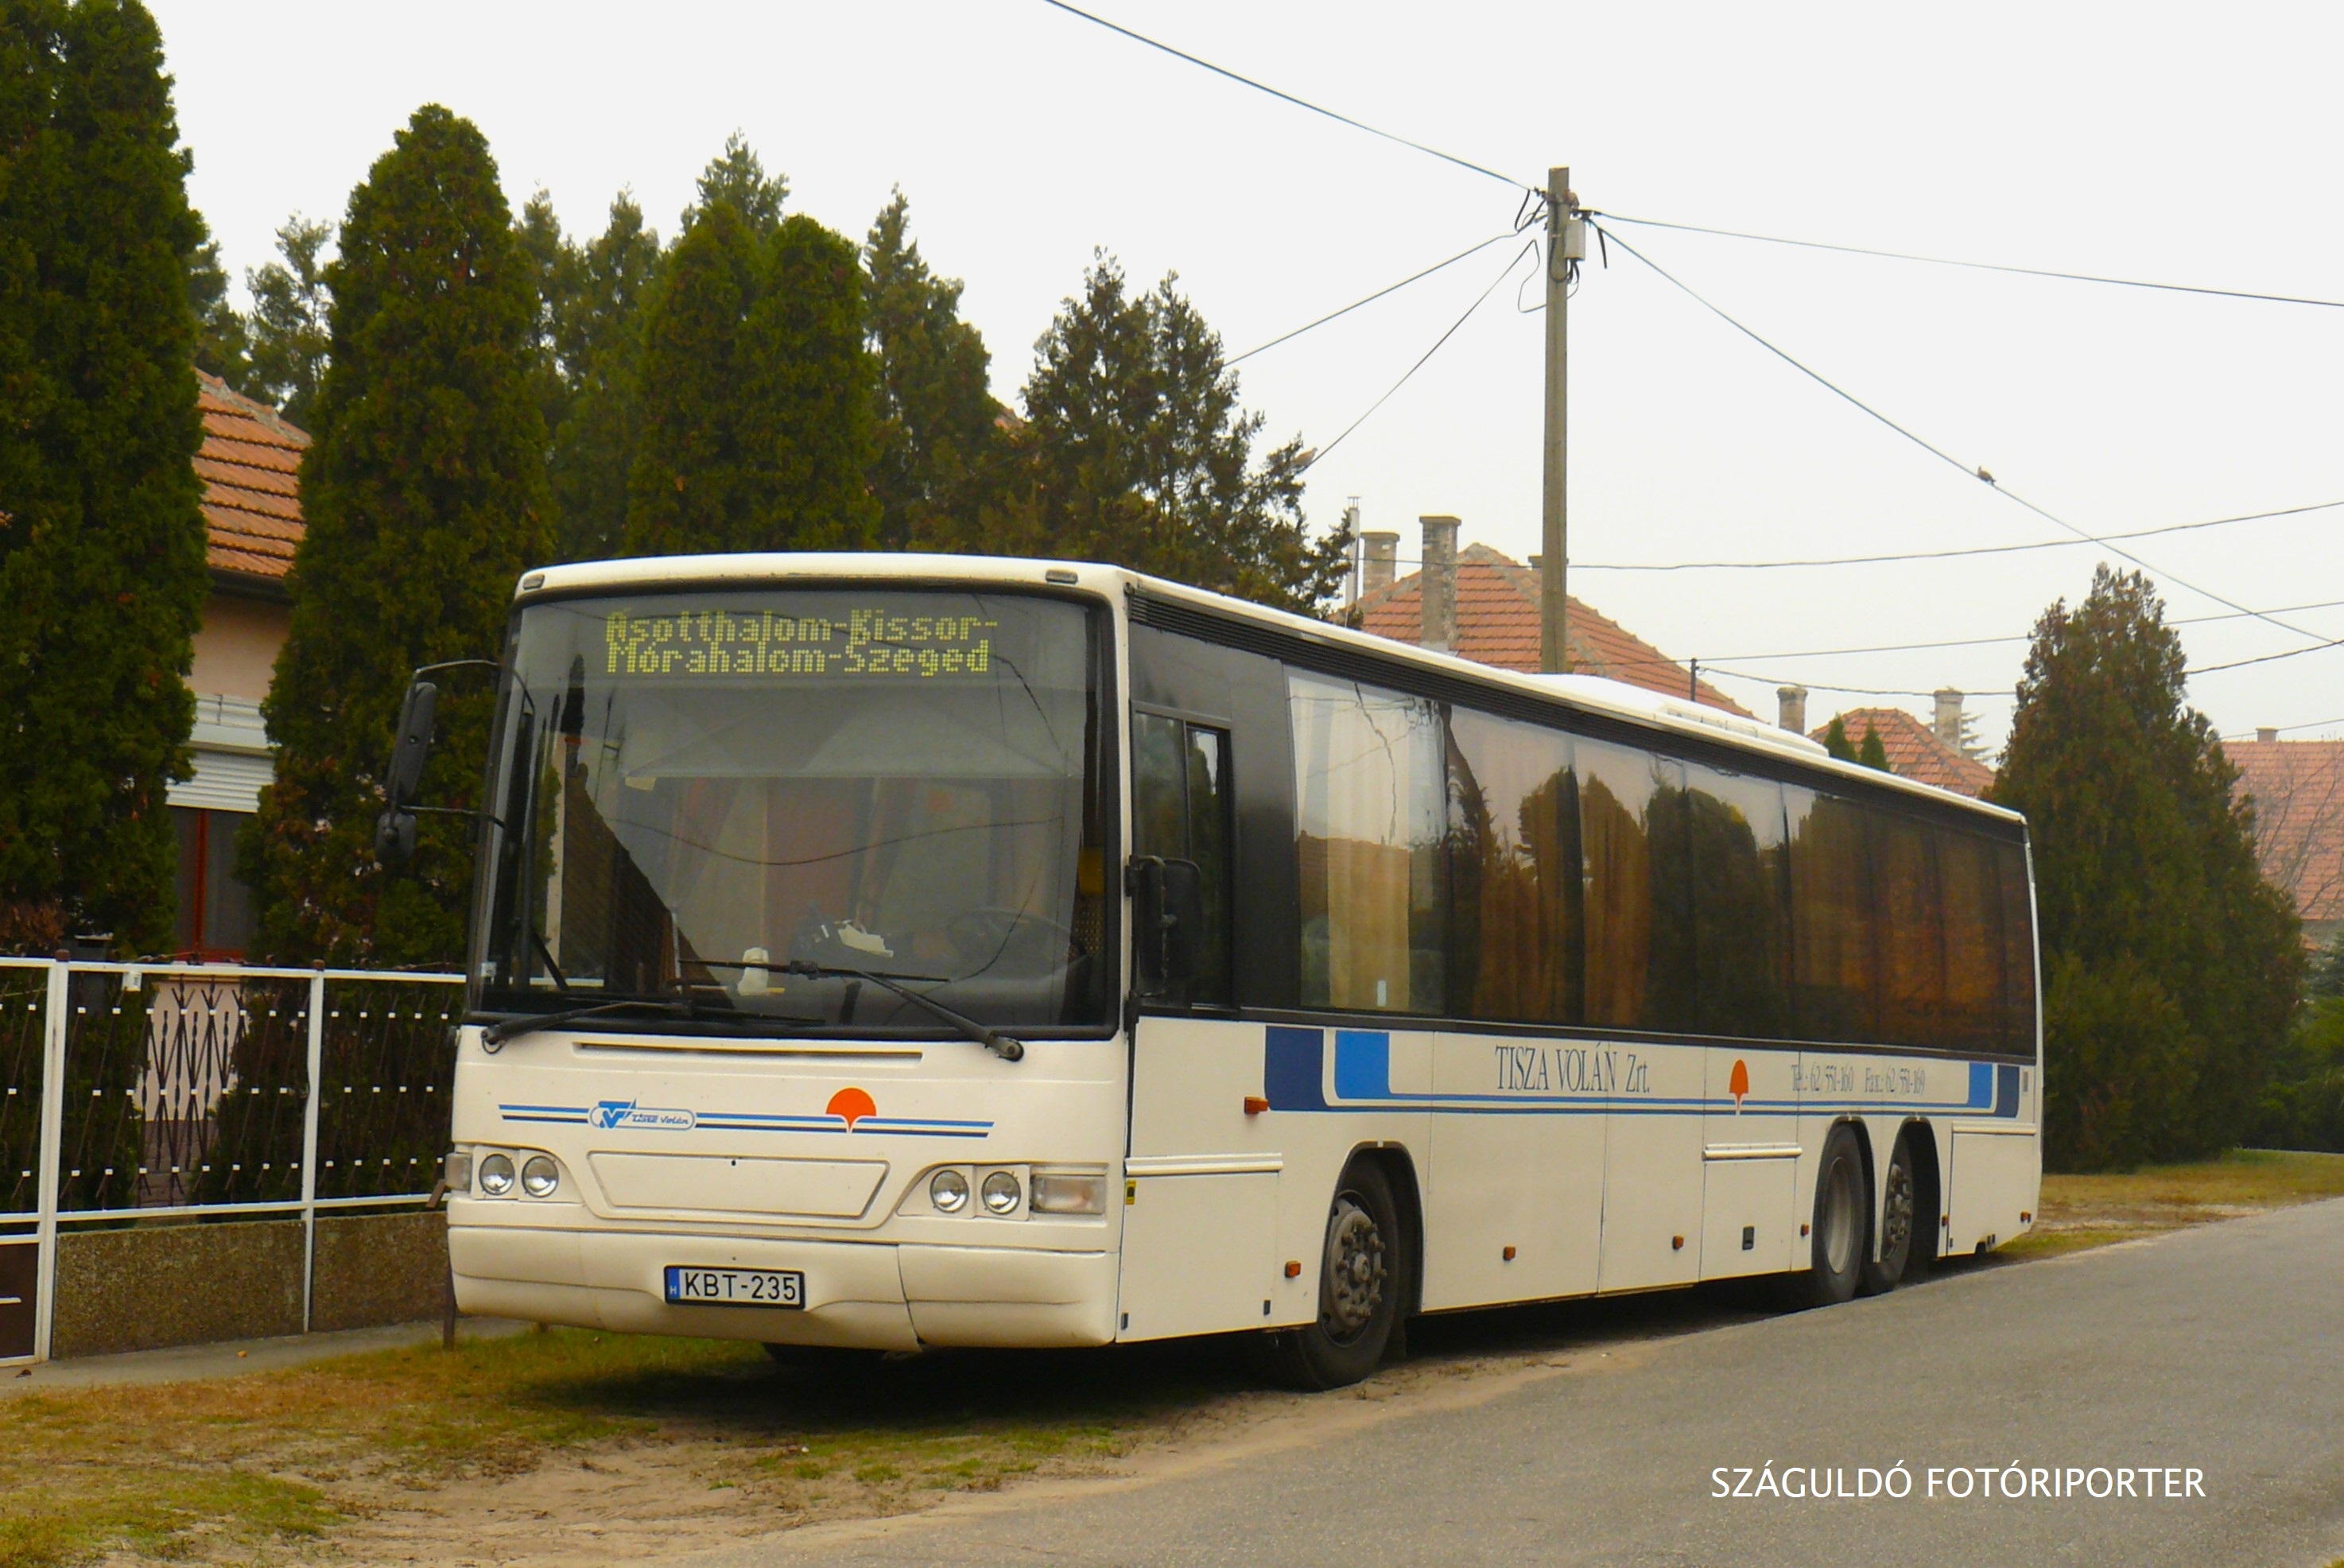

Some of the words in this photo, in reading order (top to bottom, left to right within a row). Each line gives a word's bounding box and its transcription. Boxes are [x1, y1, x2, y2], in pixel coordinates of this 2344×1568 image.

[607, 639, 988, 677] Mórahalom-Szeged
[1495, 1045, 1550, 1091] TISZA
[1556, 1042, 1617, 1093] VOLÁN
[1625, 1054, 1650, 1094] Zrt.
[669, 1286, 677, 1295] H
[685, 1272, 796, 1301] KBT-235
